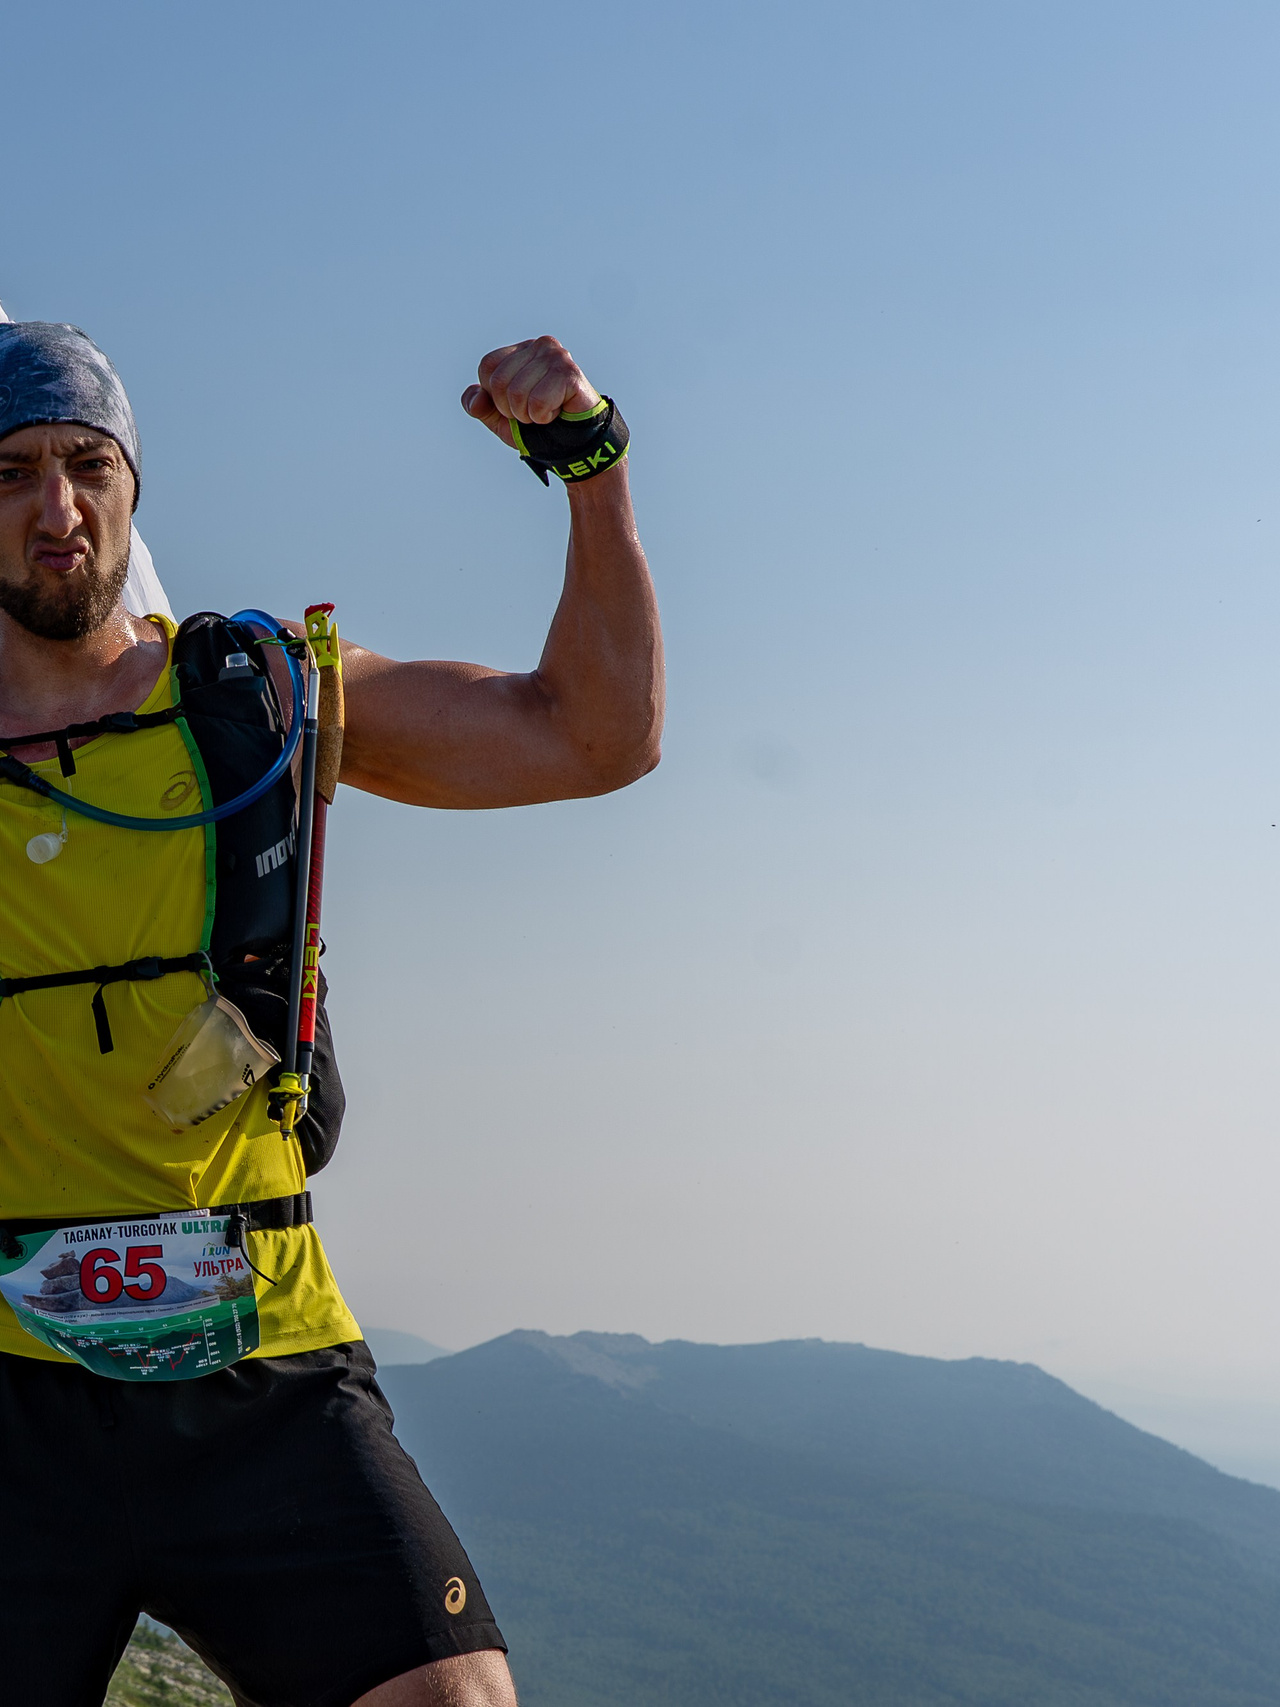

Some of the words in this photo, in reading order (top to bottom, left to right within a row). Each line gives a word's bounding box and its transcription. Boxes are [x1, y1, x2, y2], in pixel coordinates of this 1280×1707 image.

[552, 441, 617, 480] LEKI
[303, 922, 319, 999] LEKI
[63, 1222, 177, 1244] TAGANAY-TURGOYAK
[80, 1244, 167, 1304] 65
[193, 1257, 244, 1278] УЛЬТРА
